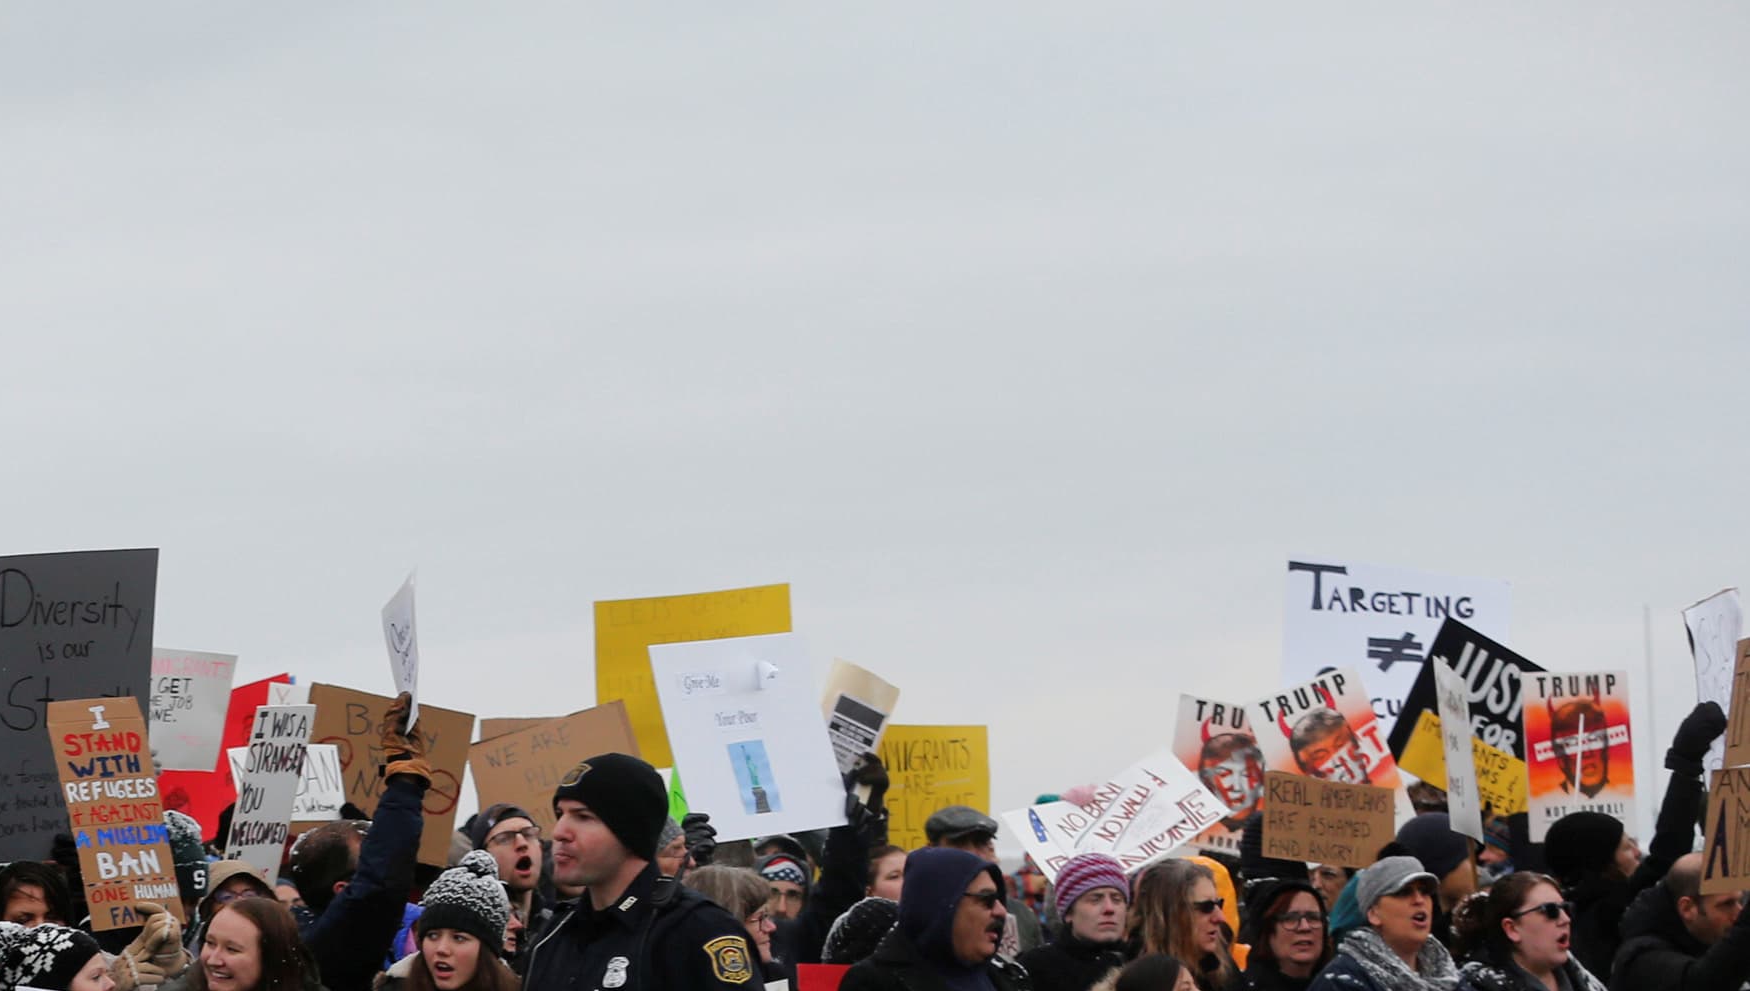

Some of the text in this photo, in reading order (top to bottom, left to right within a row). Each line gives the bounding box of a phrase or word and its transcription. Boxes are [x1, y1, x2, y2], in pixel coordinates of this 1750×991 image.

[1288, 559, 1476, 620] TARGETING
[36, 639, 96, 664] is our
[157, 677, 194, 695] GET
[1259, 672, 1347, 723] TRUMP
[1535, 674, 1617, 699] TRUMP
[169, 695, 194, 712] JOB
[88, 705, 110, 731] I
[255, 710, 308, 740] I WAS A
[64, 731, 142, 757] STAND
[484, 721, 570, 769] WE ARE
[1468, 713, 1518, 758] FOR
[68, 753, 142, 778] WITH
[64, 777, 157, 804] REFUGEES
[902, 773, 937, 796] ARE
[1268, 777, 1313, 807] REAL
[238, 781, 266, 815] YOU
[90, 802, 160, 823] AGAINST
[1545, 805, 1568, 818] NOT
[76, 823, 170, 849] A MUSLIM
[229, 820, 288, 848] WELCOMED
[1057, 811, 1089, 839] NO
[1093, 822, 1124, 844] NO
[96, 848, 162, 880] BAN
[193, 869, 207, 890] S
[91, 882, 179, 904] ONE HUMAN
